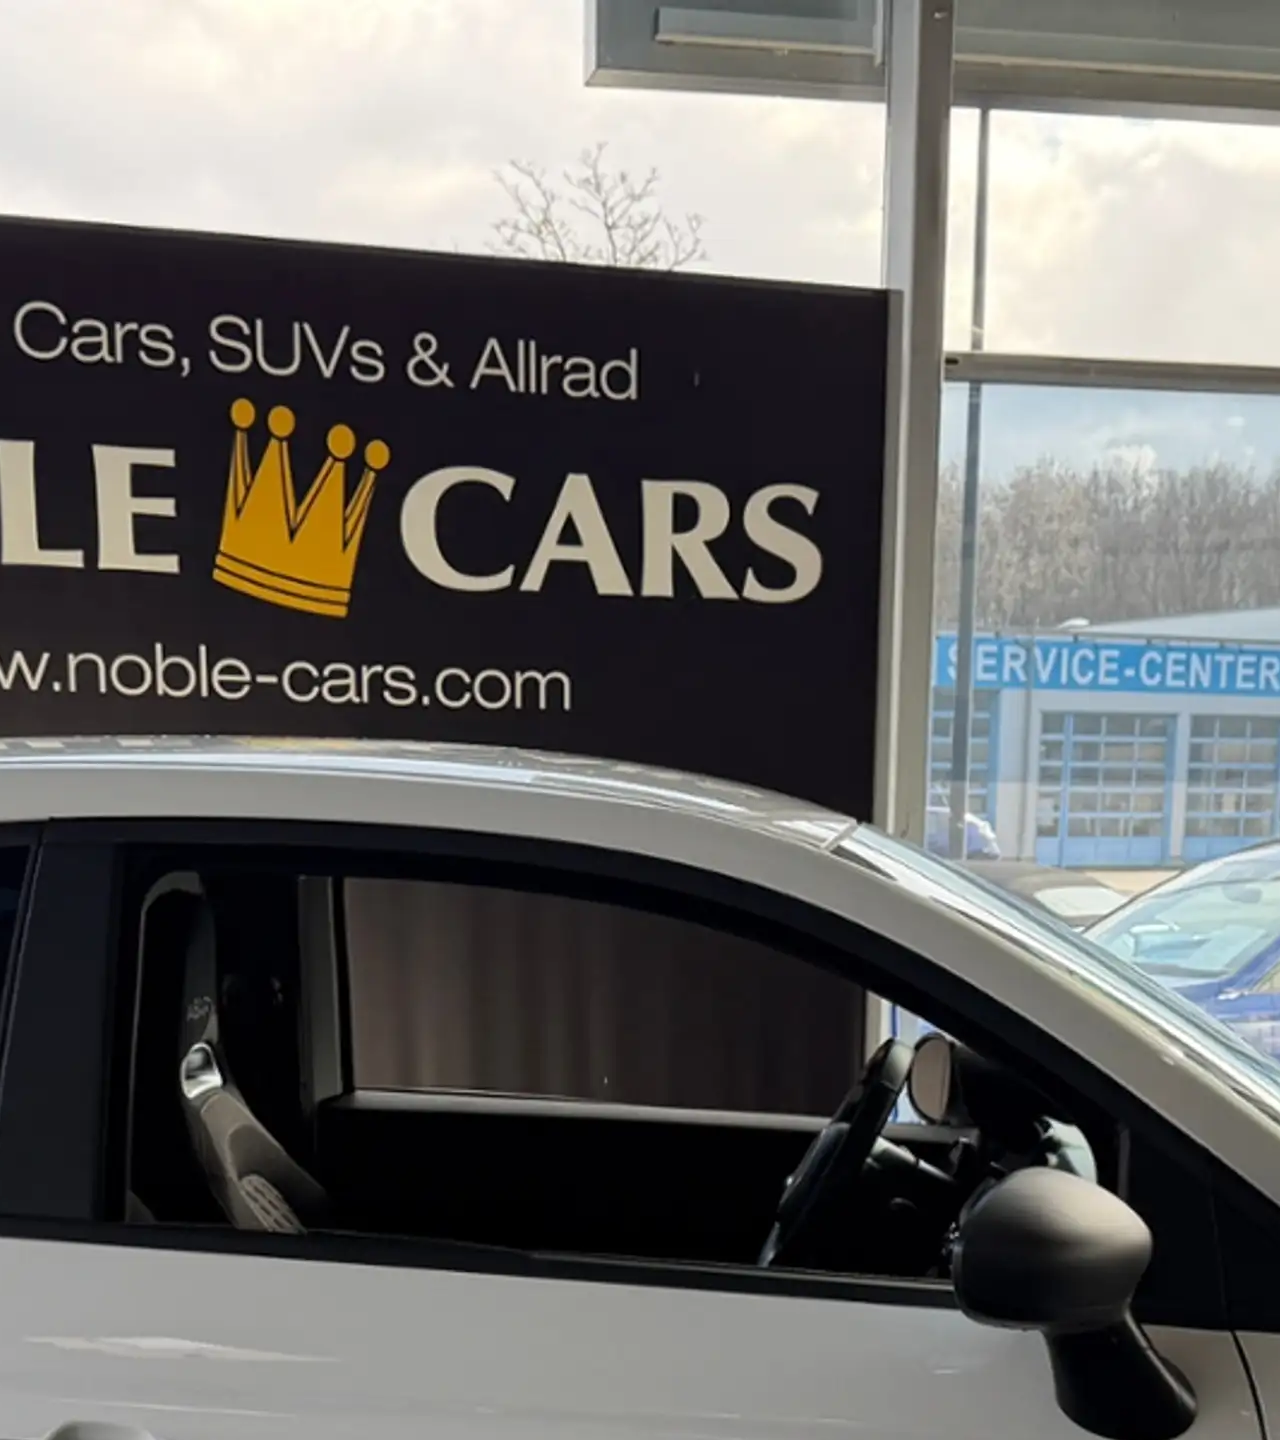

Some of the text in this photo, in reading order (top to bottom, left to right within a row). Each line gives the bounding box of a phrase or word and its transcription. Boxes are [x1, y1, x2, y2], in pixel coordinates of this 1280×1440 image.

[14, 301, 190, 376] Cars,
[209, 315, 385, 382] SUVs
[407, 332, 454, 387] &
[470, 338, 637, 400] Allrad
[399, 466, 823, 602] CARS
